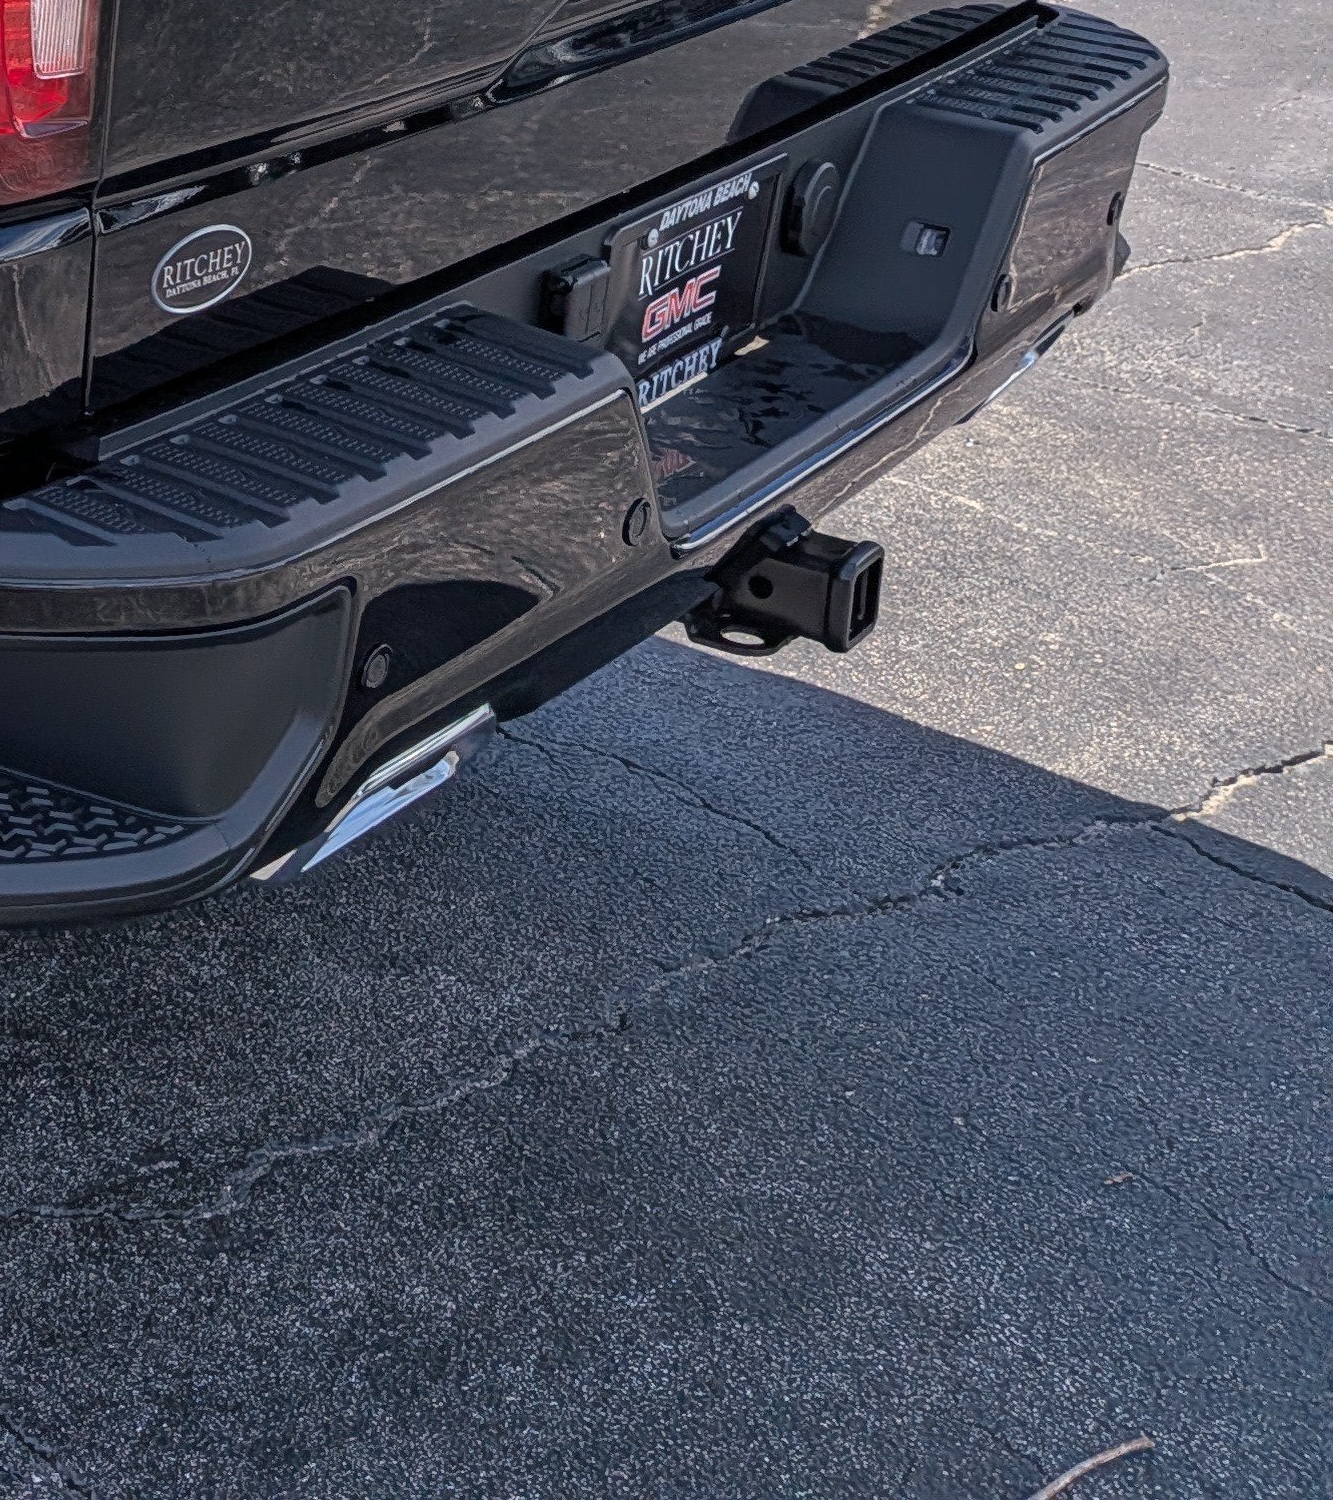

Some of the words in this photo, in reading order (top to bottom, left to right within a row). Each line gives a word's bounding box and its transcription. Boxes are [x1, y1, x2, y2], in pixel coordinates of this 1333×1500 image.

[659, 190, 713, 231] DAYTONA
[713, 172, 752, 207] BEACH
[162, 240, 246, 289] RITCHEY
[639, 210, 743, 297] RITCHEY
[165, 278, 202, 299] DAYTONA
[642, 264, 722, 343] GMC
[636, 337, 722, 407] RITCHEY
